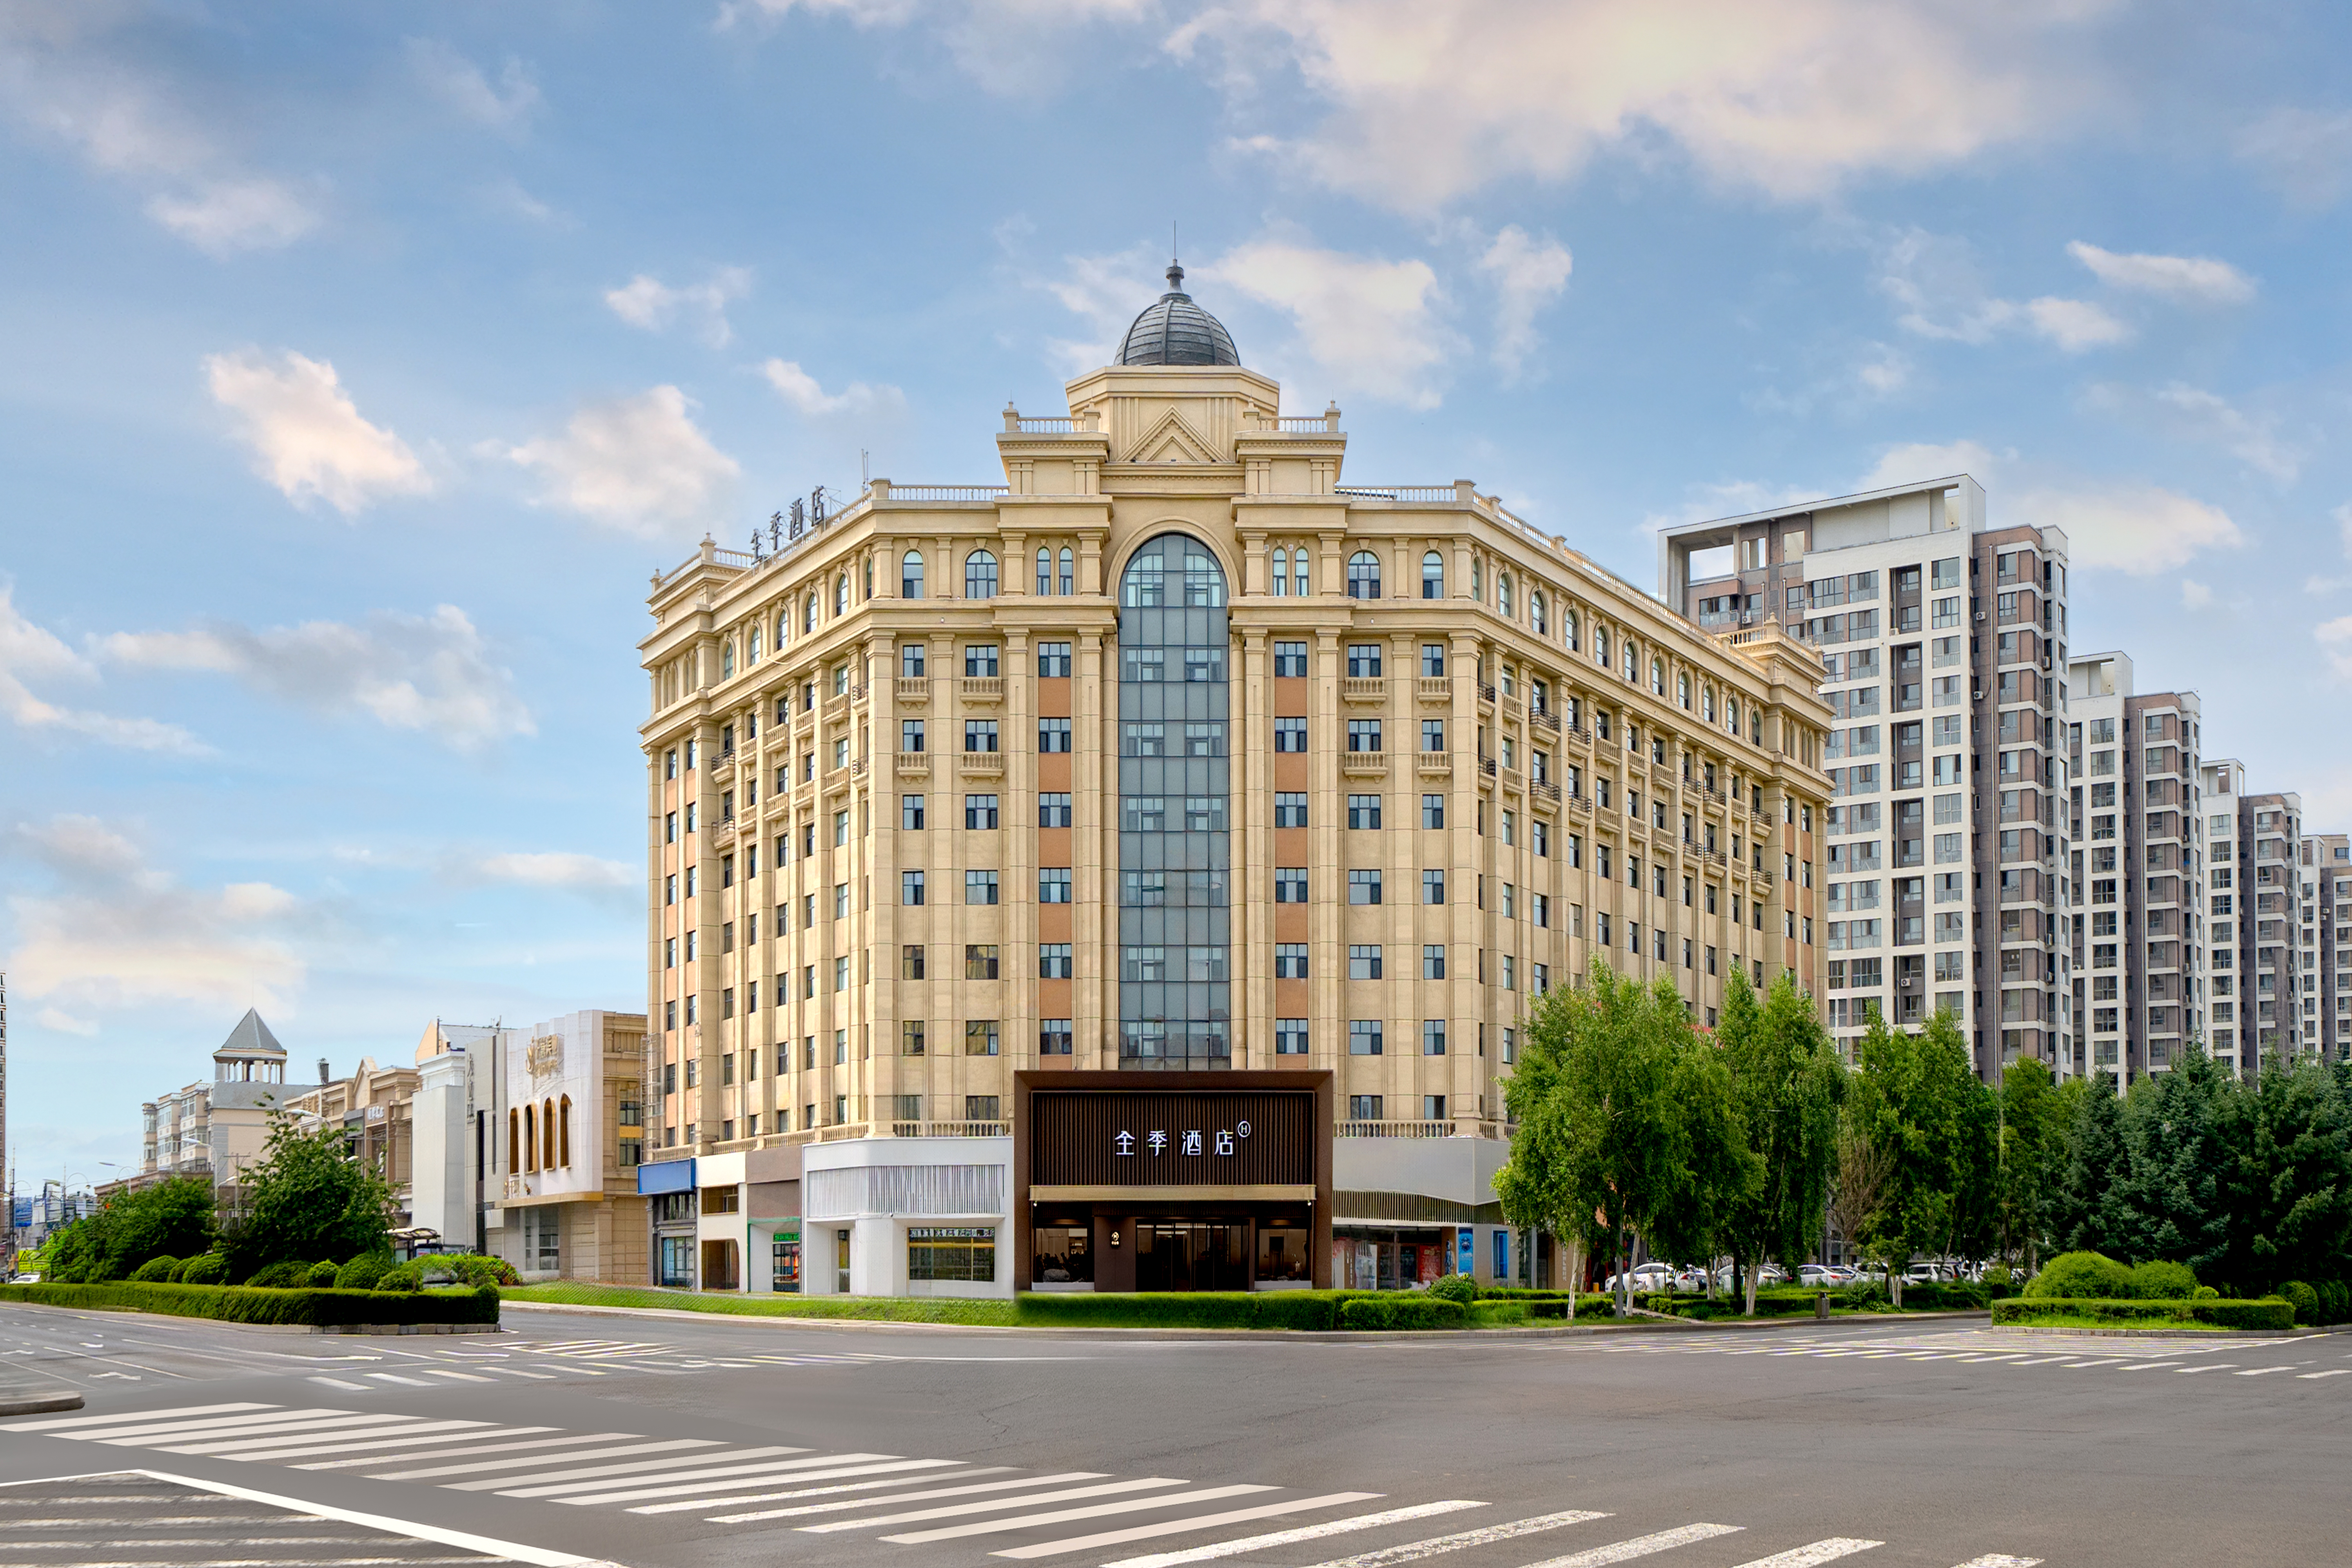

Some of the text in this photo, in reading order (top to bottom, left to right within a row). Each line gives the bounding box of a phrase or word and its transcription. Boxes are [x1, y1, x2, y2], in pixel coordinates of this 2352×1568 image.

[750, 485, 824, 565] 全季酒店
[1115, 1129, 1234, 1156] 全季酒店
